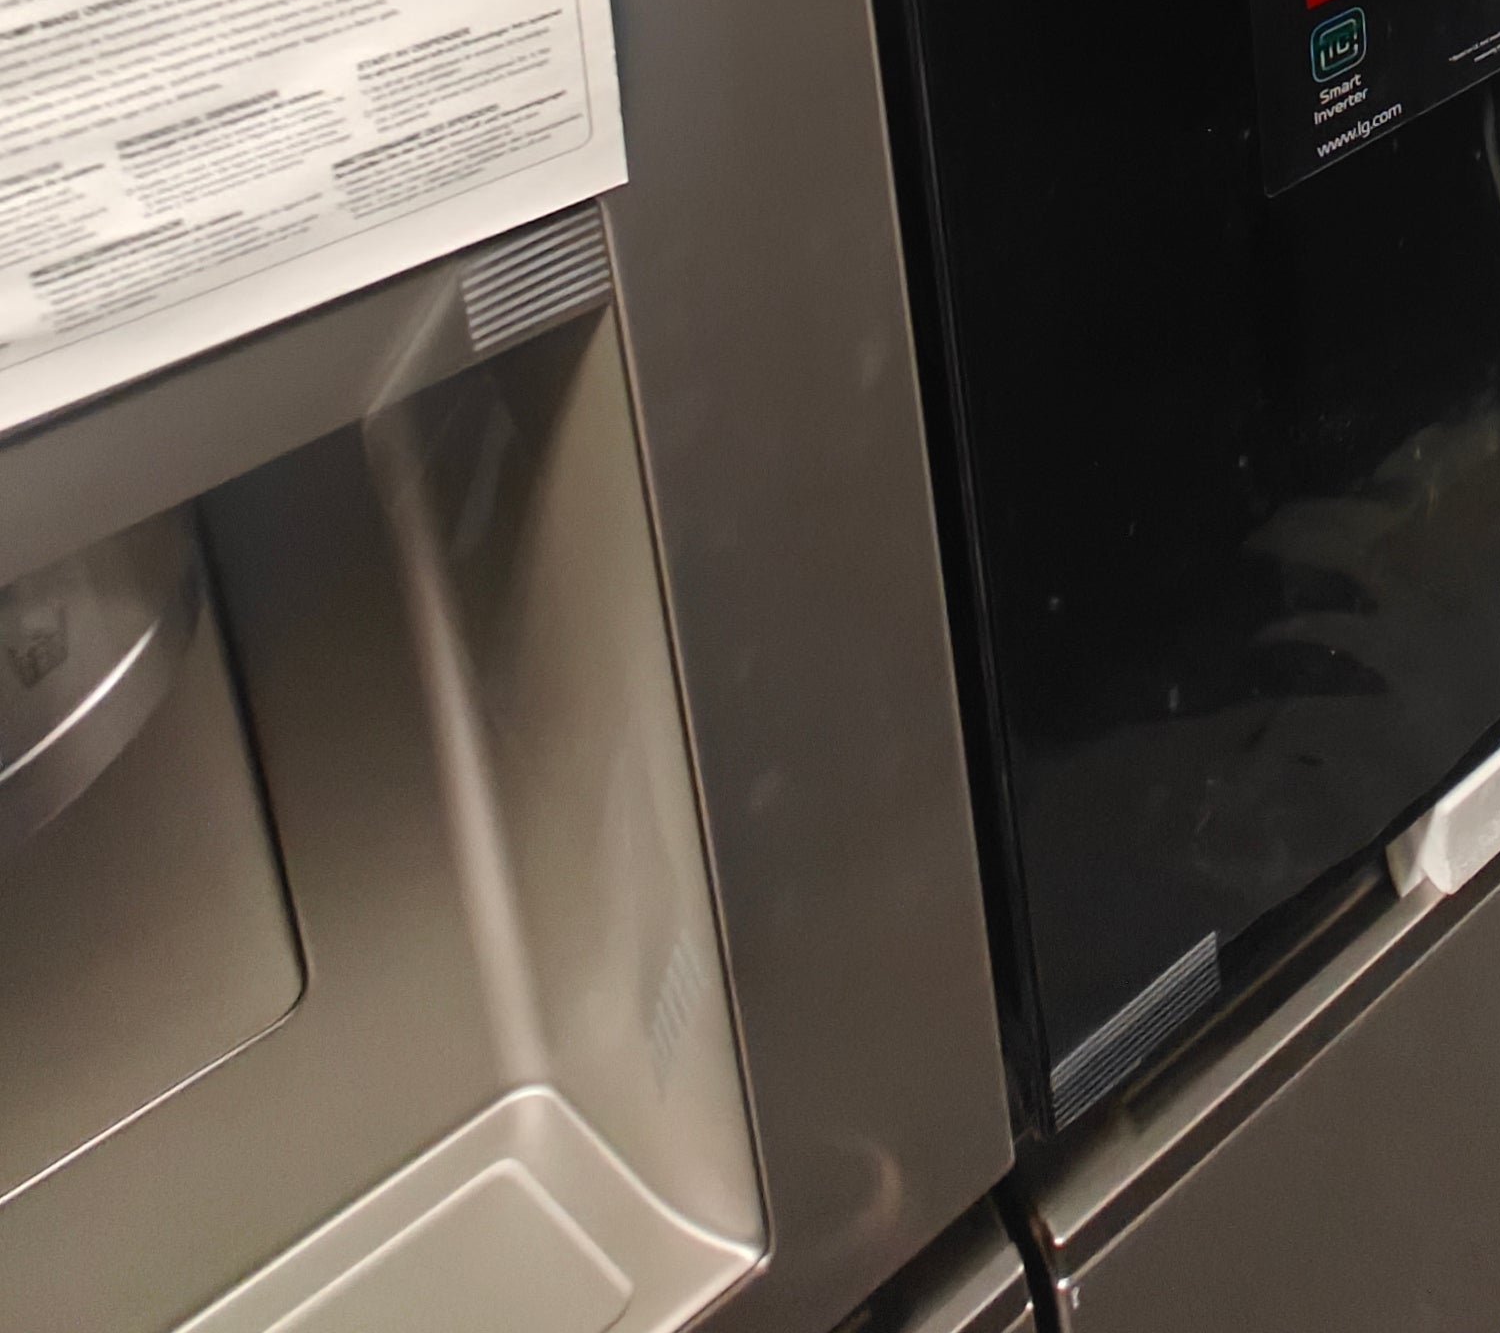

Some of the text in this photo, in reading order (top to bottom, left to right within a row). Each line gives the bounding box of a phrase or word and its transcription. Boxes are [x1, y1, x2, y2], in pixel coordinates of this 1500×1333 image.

[1313, 87, 1369, 126] Inverter
[1318, 73, 1362, 105] Smart
[1316, 102, 1403, 158] www.lg.com
